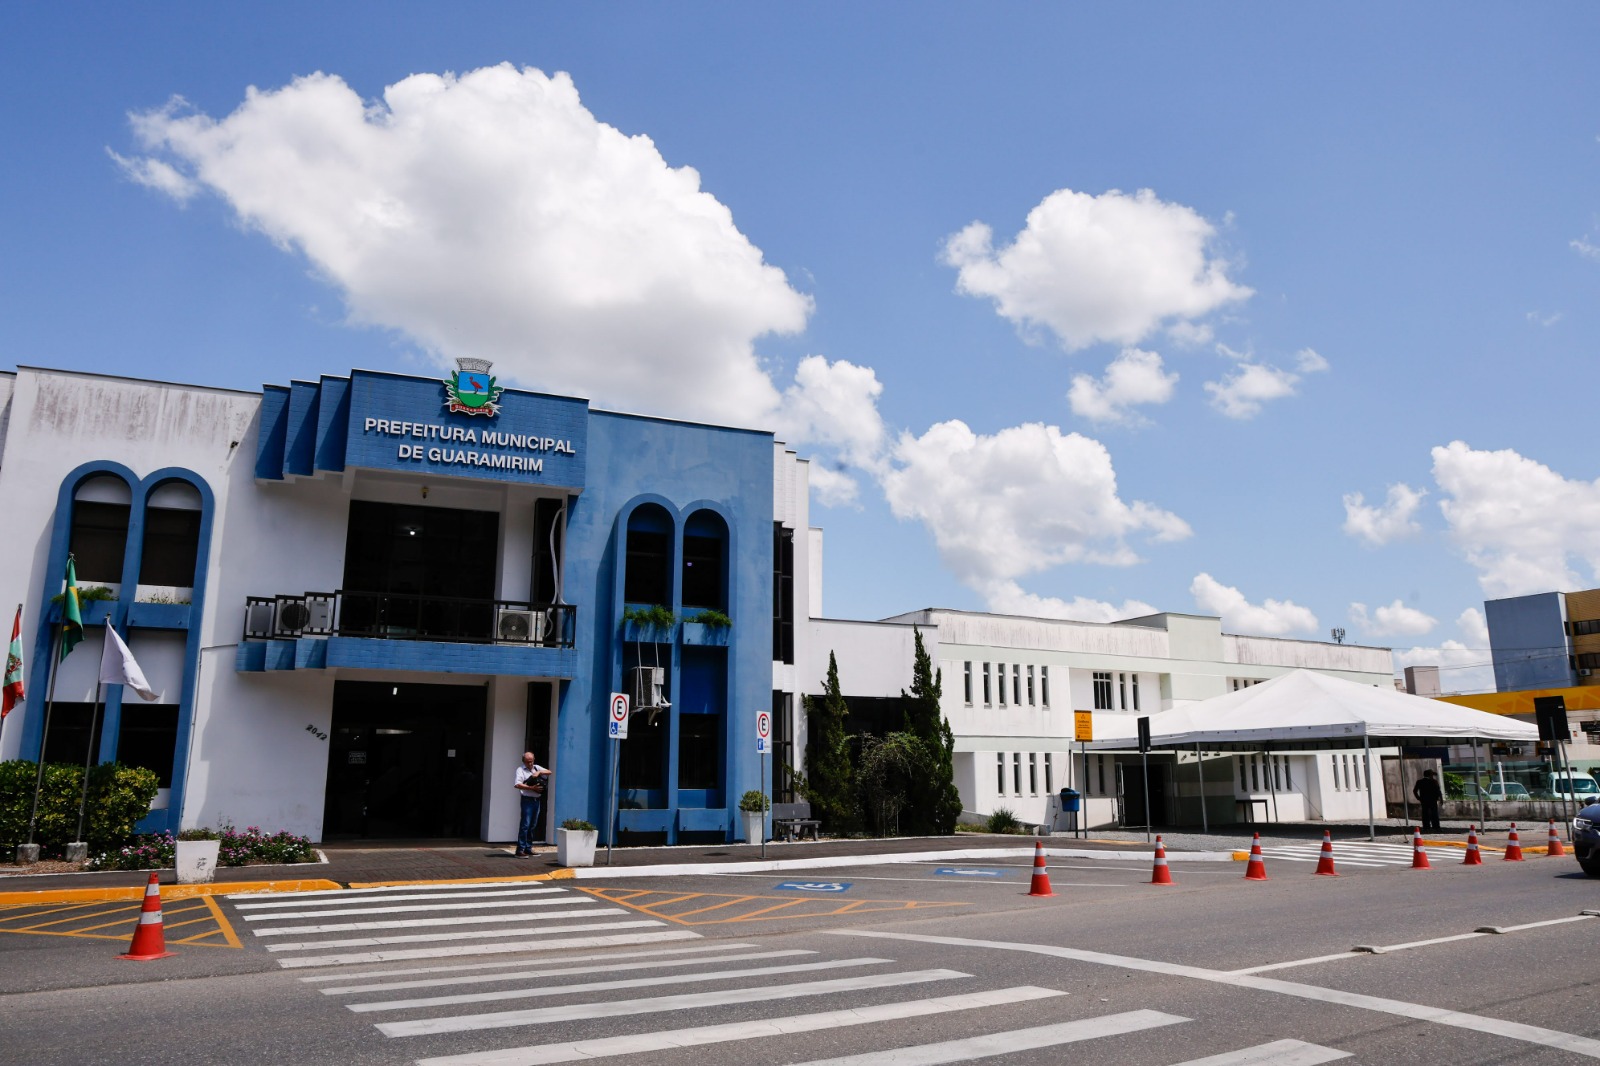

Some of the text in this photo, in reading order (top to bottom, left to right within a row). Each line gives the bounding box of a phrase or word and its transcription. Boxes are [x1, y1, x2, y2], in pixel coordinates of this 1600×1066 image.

[364, 417, 576, 454] PREFEITURA MUNICIPAL
[398, 444, 543, 472] DE GUARAMIRIM
[617, 700, 623, 715] E
[761, 718, 766, 731] E
